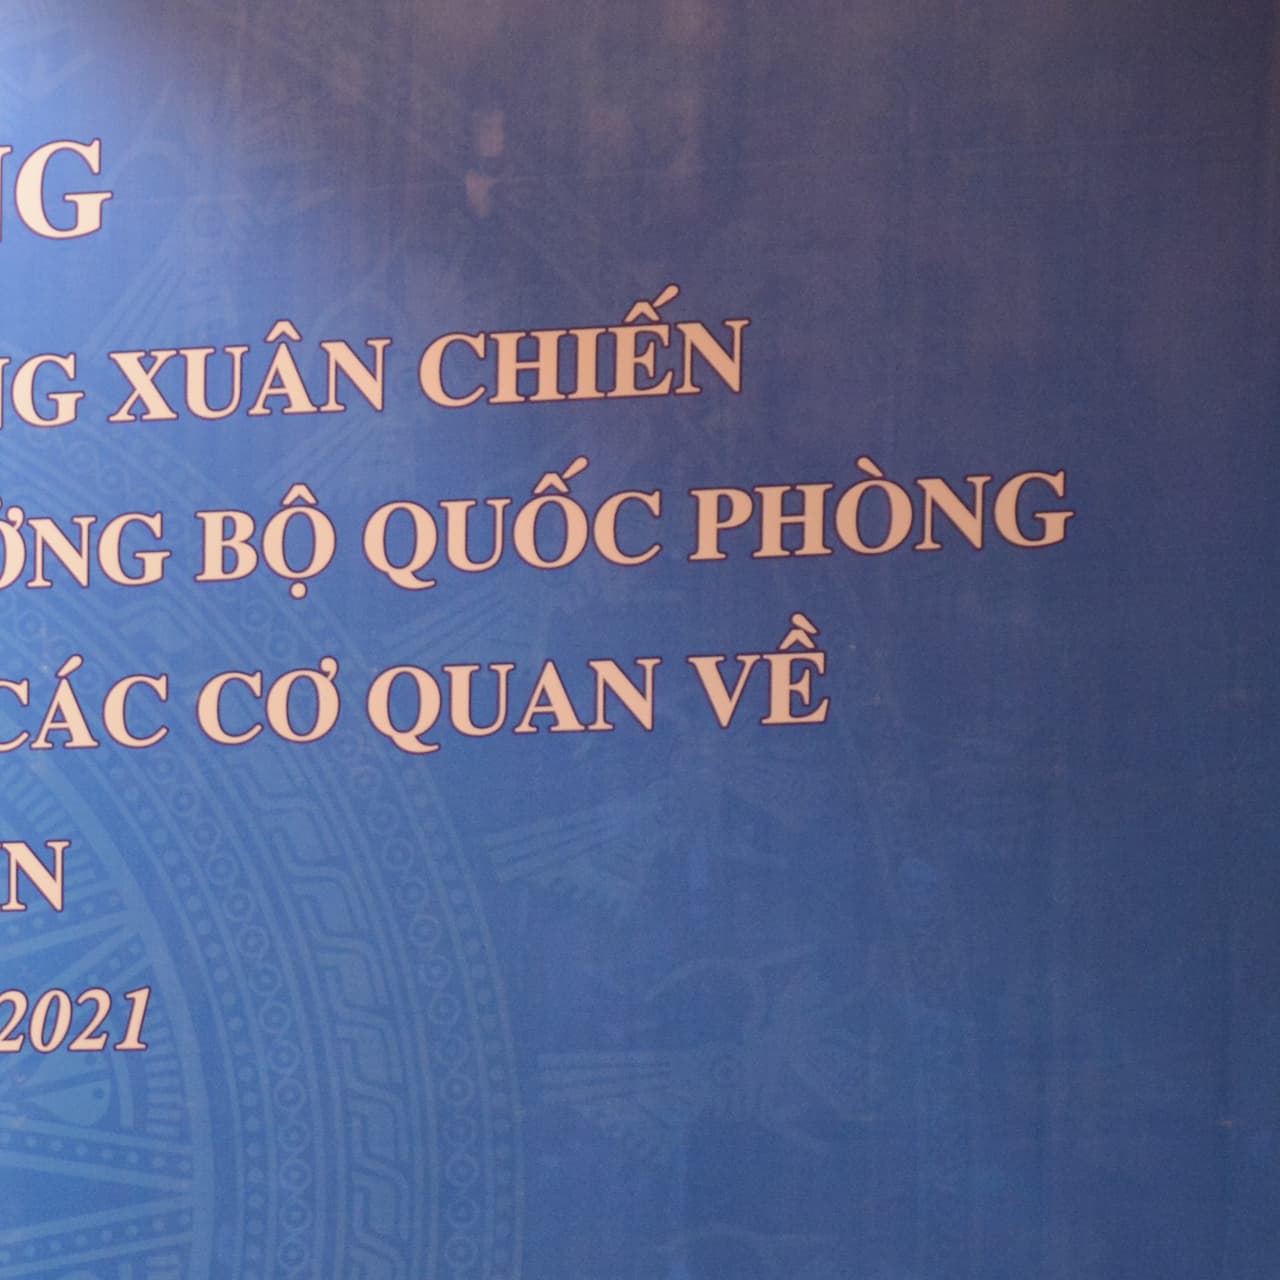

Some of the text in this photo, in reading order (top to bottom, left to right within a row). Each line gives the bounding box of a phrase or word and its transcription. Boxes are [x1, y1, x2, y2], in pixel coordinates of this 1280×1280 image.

[107, 319, 392, 424] XUÂN
[418, 284, 750, 409] CHIẾN
[194, 483, 337, 600] BỘ
[362, 456, 662, 591] QUỐC
[688, 456, 1075, 562] PHÒNG
[196, 656, 341, 746] CƠ
[366, 657, 662, 755] QUAN
[687, 612, 830, 728] VỀ
